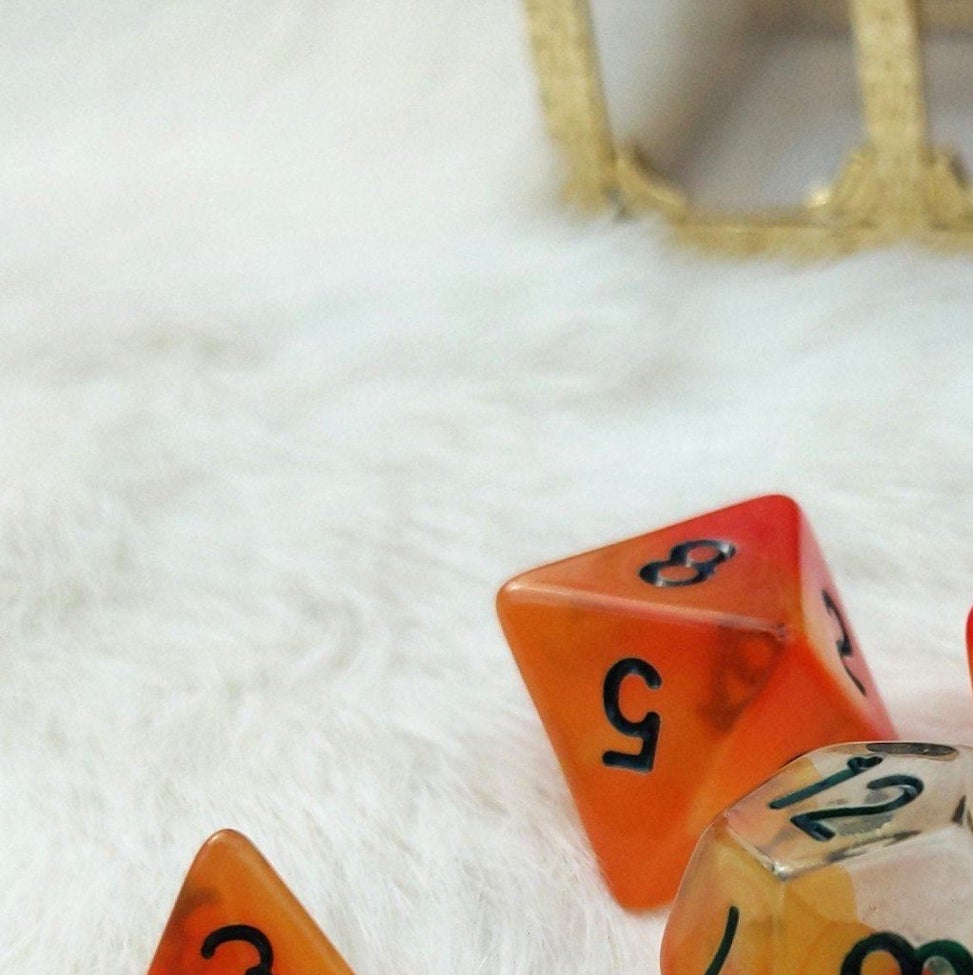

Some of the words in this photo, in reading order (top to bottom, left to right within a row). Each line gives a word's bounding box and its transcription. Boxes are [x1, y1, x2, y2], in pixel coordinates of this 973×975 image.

[639, 539, 736, 588] 8
[602, 657, 662, 774] 5
[769, 755, 924, 841] 12
